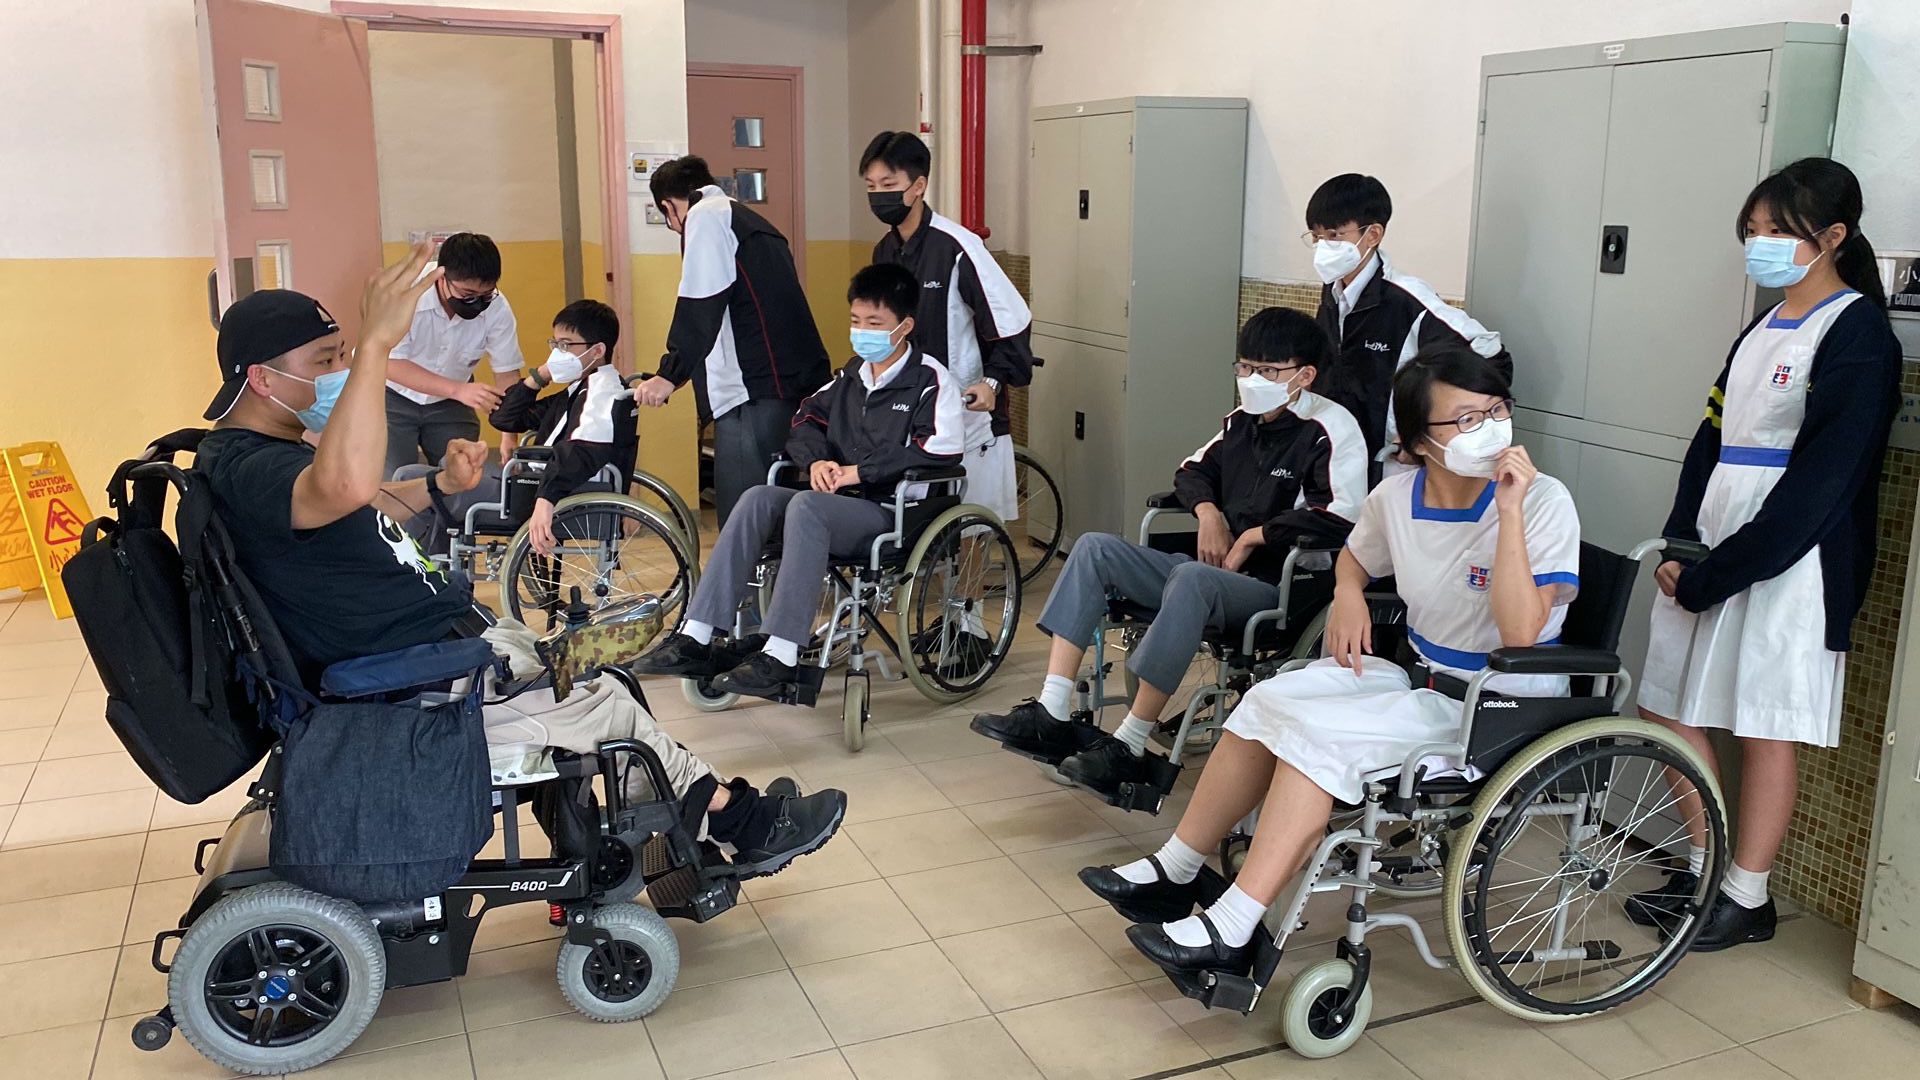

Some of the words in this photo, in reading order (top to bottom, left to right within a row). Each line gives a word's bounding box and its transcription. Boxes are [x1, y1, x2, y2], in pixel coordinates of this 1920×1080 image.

[1899, 265, 1920, 285] 小
[28, 475, 66, 489] CAUTION
[26, 488, 45, 499] WET
[47, 483, 74, 496] FLOOR
[510, 881, 547, 891] B400
